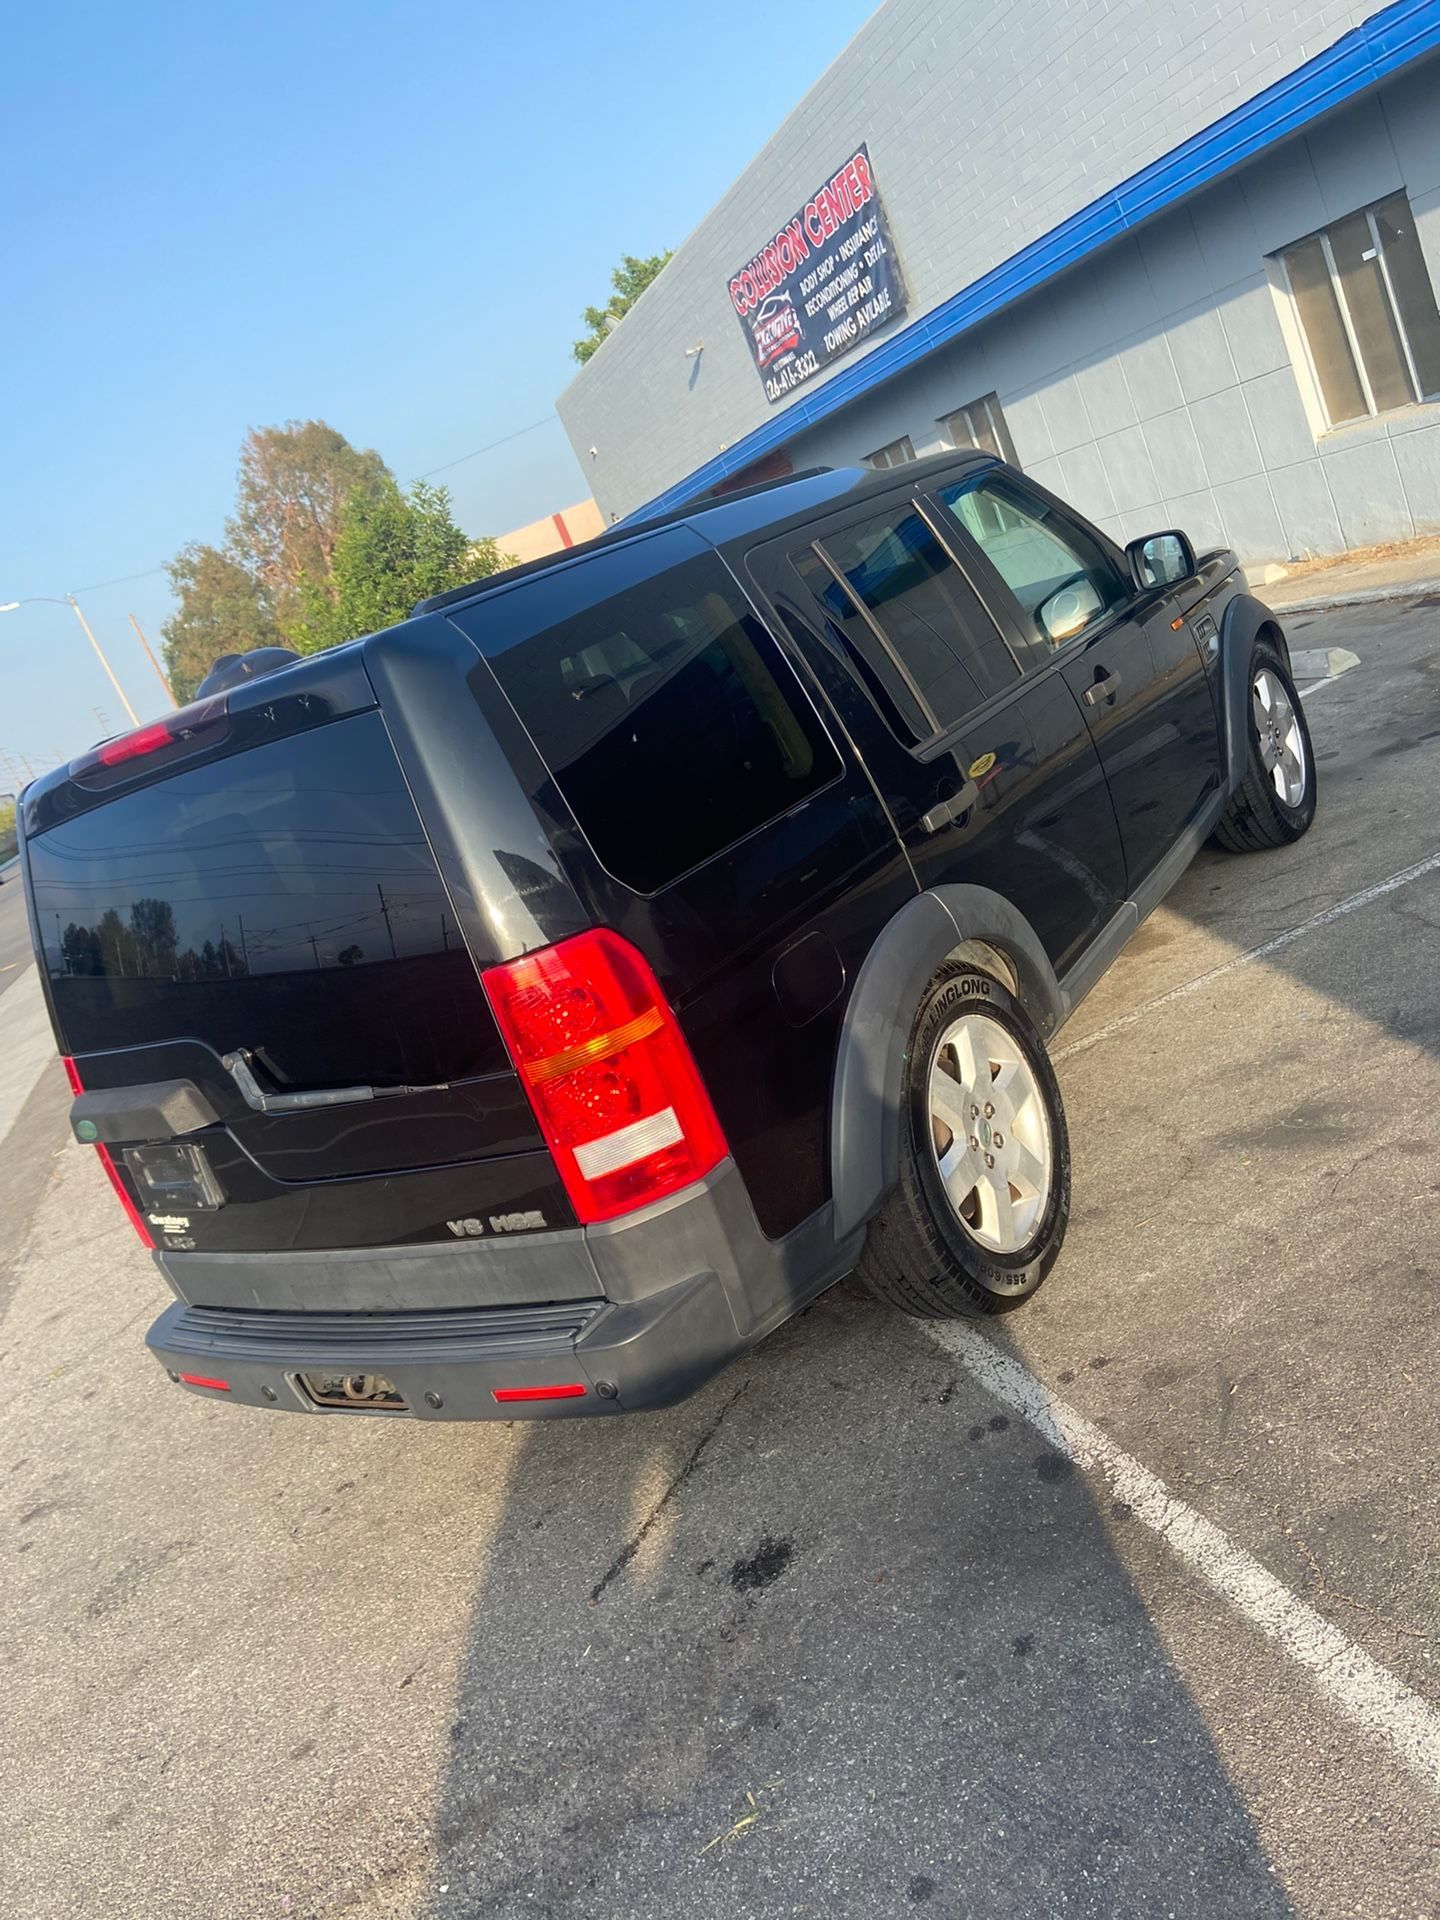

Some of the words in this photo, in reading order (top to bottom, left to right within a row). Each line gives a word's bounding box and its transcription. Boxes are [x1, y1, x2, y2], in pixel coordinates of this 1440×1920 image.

[730, 218, 810, 316] COLLISION
[804, 153, 873, 248] CENTER
[800, 270, 818, 296] BODY
[817, 256, 834, 281] SHOP
[804, 262, 858, 317] RECONDITIONING
[827, 295, 849, 321] WHEEL
[847, 275, 873, 306] REPAIR
[823, 316, 857, 352] TOWING
[766, 349, 819, 401] 26-416-3322
[929, 978, 991, 1028] LINGLONG
[446, 1218, 484, 1237] V8
[488, 1210, 548, 1233] HSE
